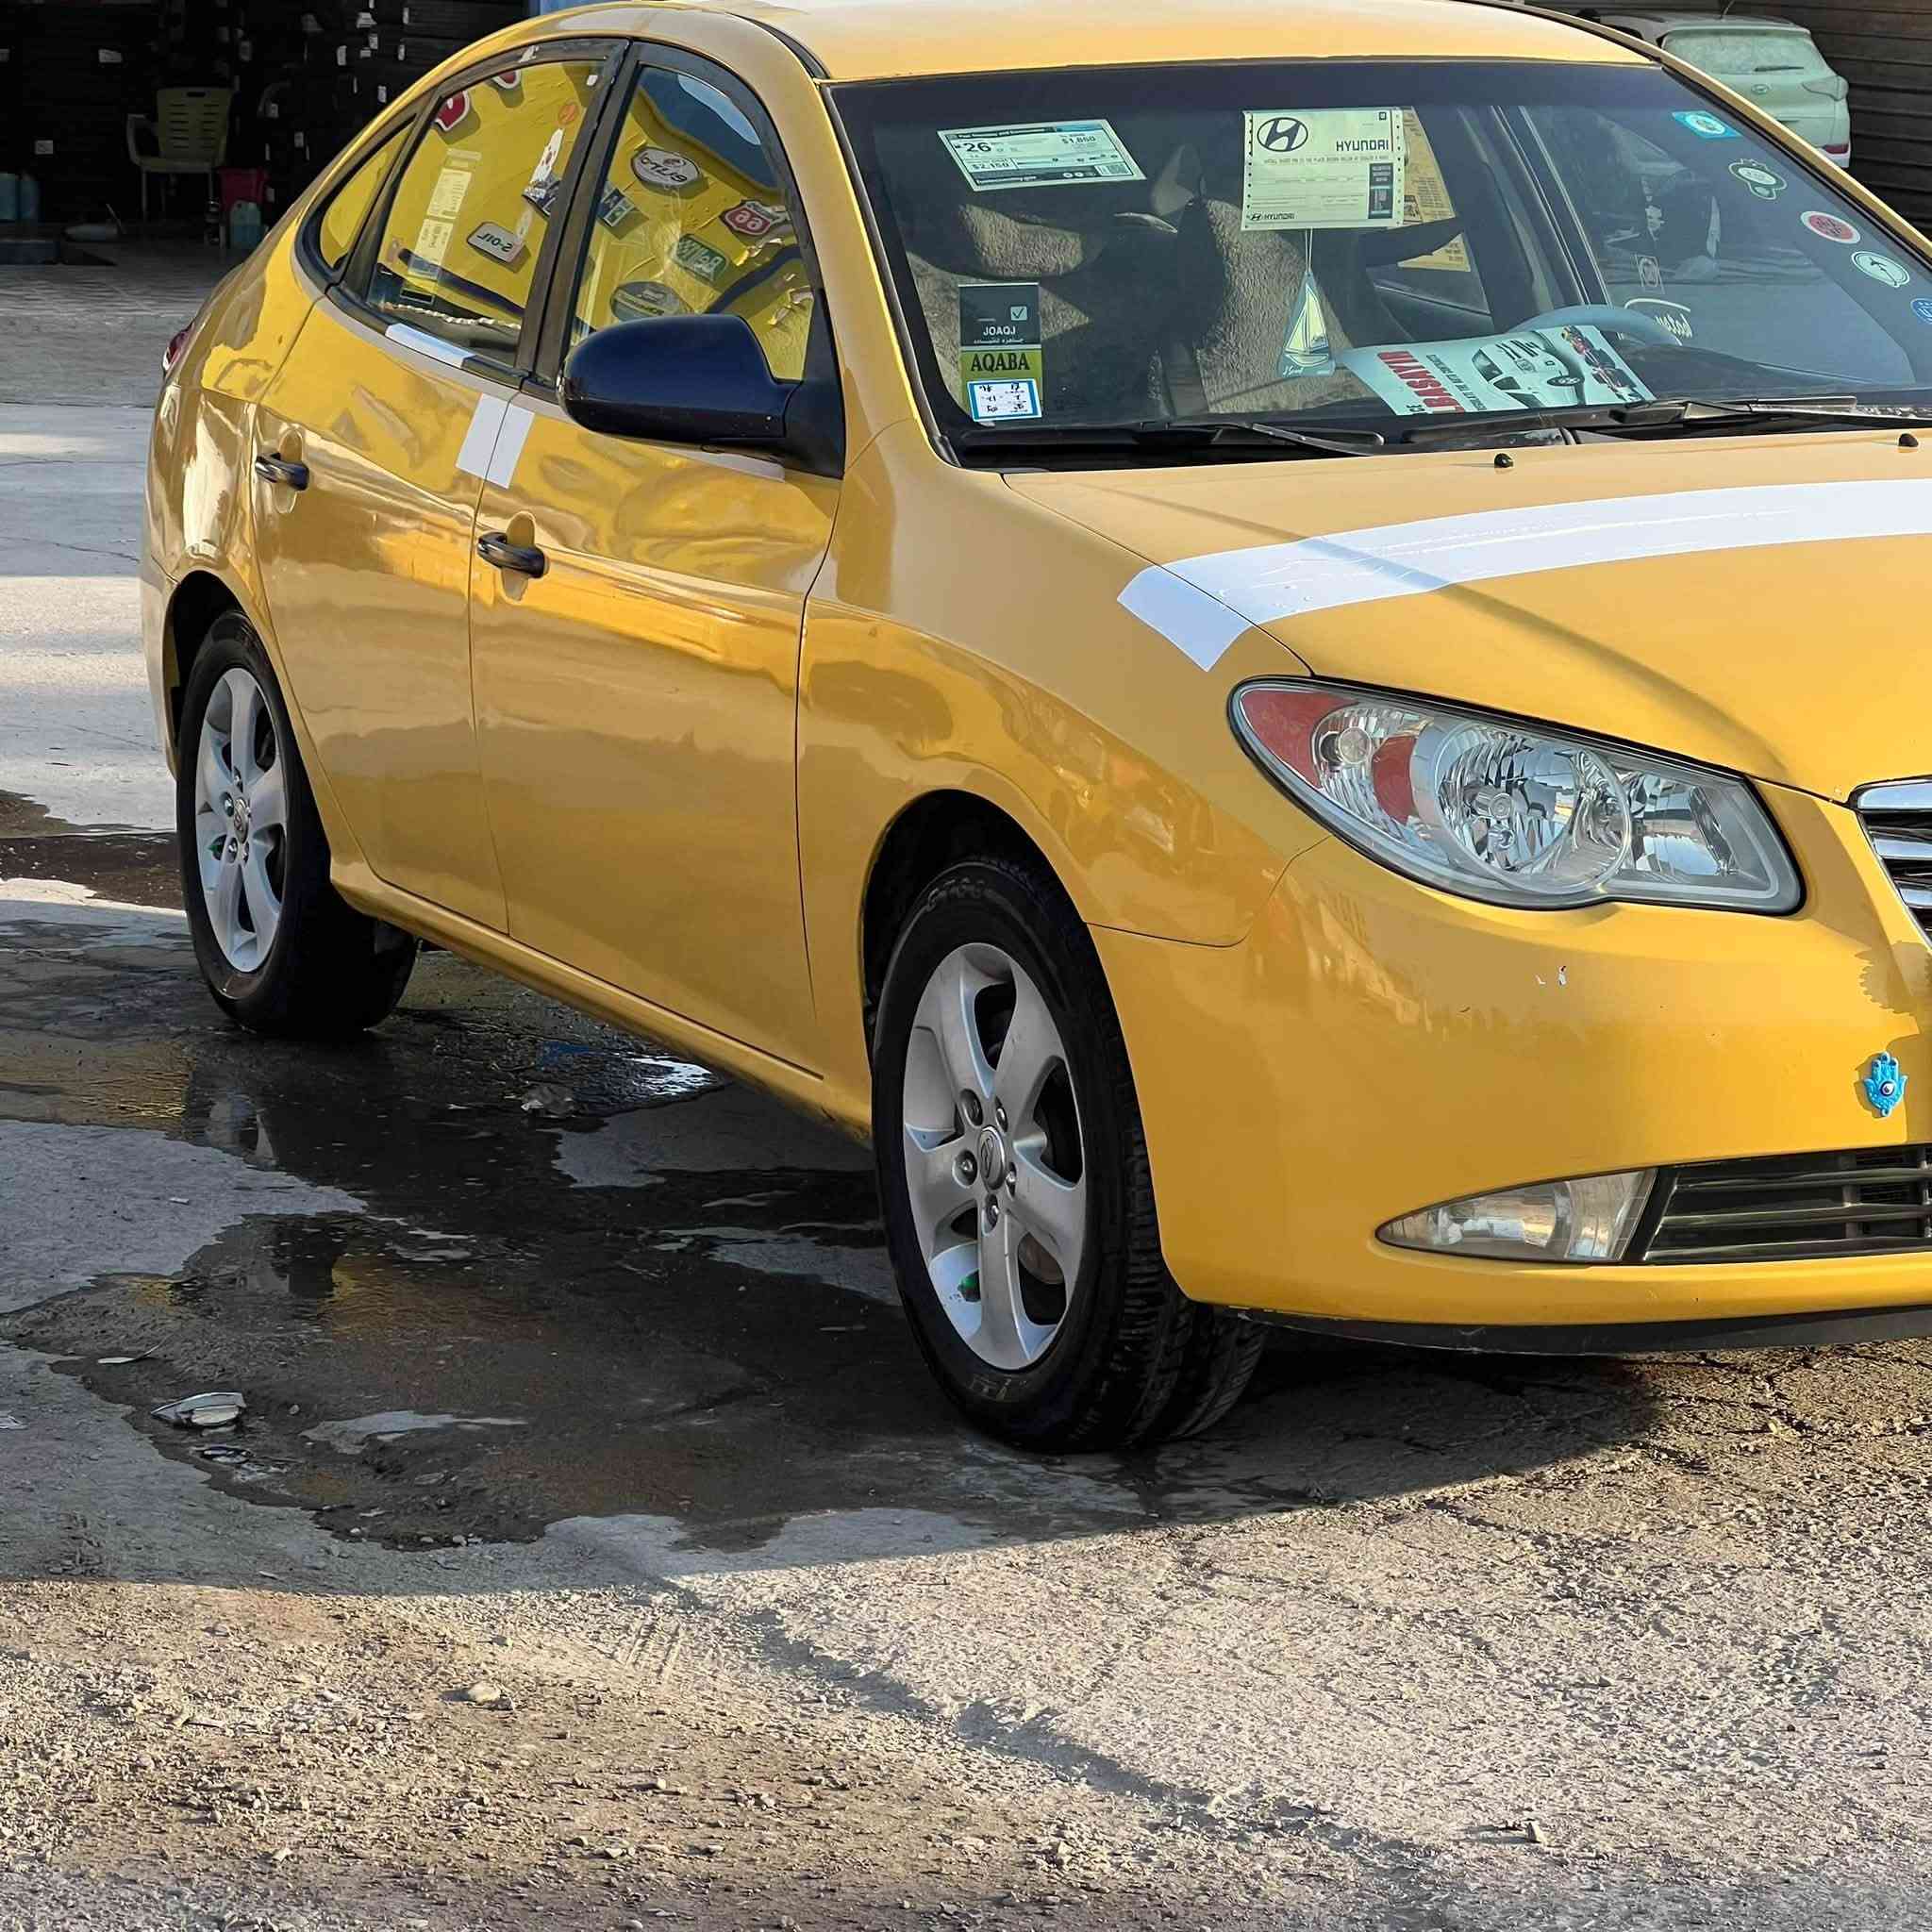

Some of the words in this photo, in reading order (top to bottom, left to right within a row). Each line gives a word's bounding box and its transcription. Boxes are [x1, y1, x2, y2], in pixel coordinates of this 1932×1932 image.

[963, 142, 992, 152] 26
[1336, 139, 1389, 152] HYUNDAI
[970, 352, 1030, 373] AQABA
